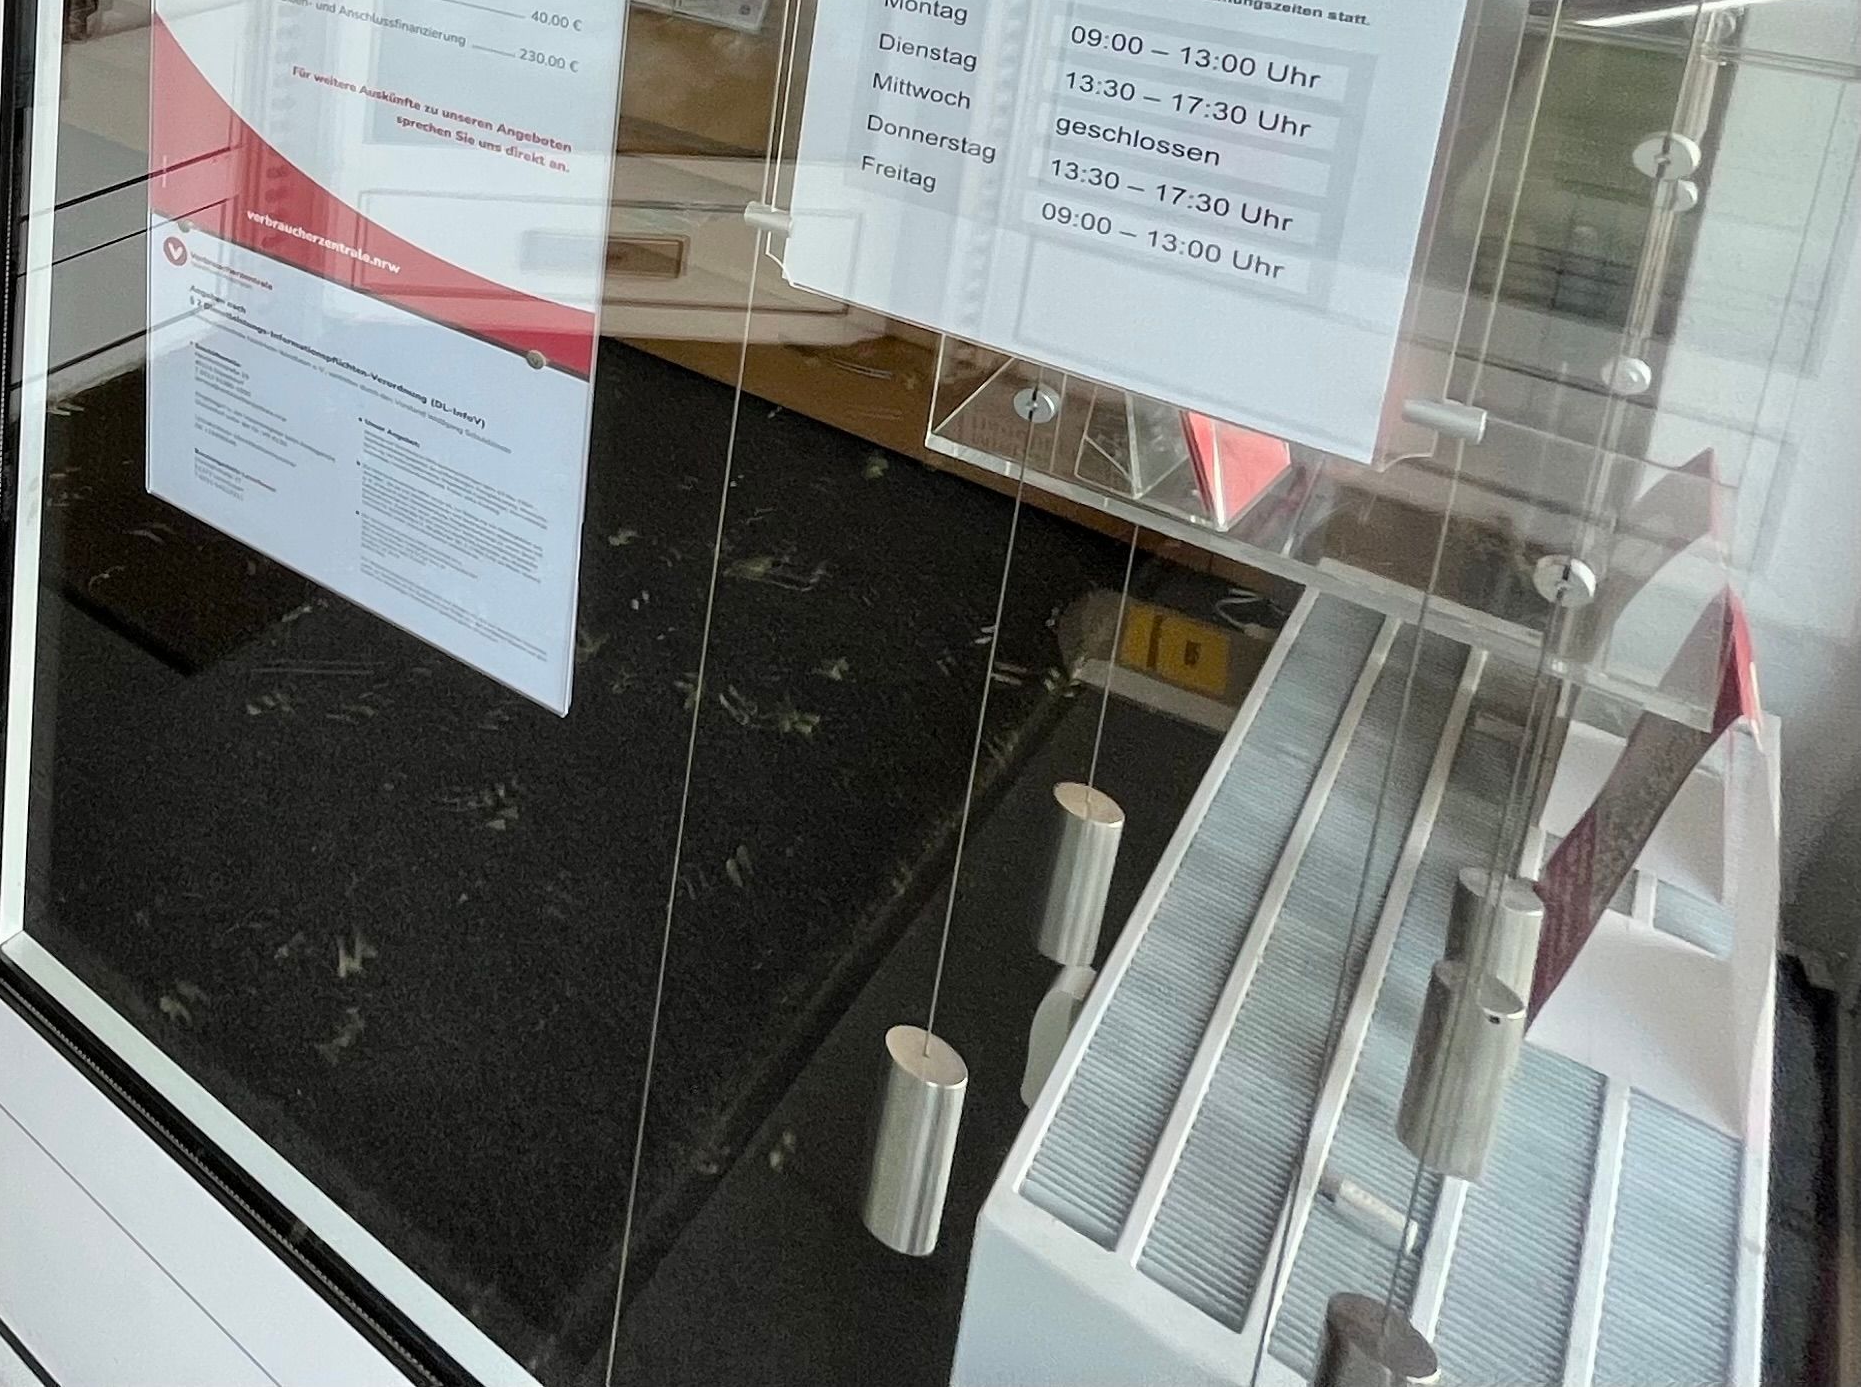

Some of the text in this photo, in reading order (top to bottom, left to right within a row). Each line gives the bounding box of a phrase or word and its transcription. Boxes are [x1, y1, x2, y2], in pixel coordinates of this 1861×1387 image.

[339, 4, 467, 48] Anschlussfinanzierung
[519, 47, 566, 70] 230,00
[531, 10, 570, 29] 40,00
[1327, 8, 1371, 27] statt.
[878, 32, 978, 73] Dienstag
[1071, 25, 1322, 89] 09:00 13:00 Uhr
[292, 65, 573, 153] Für weitere Auskünfte zu unseren Angeboten
[872, 72, 971, 110] Mittwoch
[1065, 71, 1312, 138] 13:30 17:30 Uhr
[395, 115, 571, 174] sprechen Sie uns direkt an.
[867, 114, 996, 164] Donnerstag
[1055, 116, 1221, 167] geschlossen
[861, 155, 937, 193] Freitag
[1051, 159, 1294, 232] 13:30 17:30 Uhr
[245, 208, 402, 275] verbraucherzentrale.nrw
[1041, 202, 1286, 279] 09:00 13:00 Uhr
